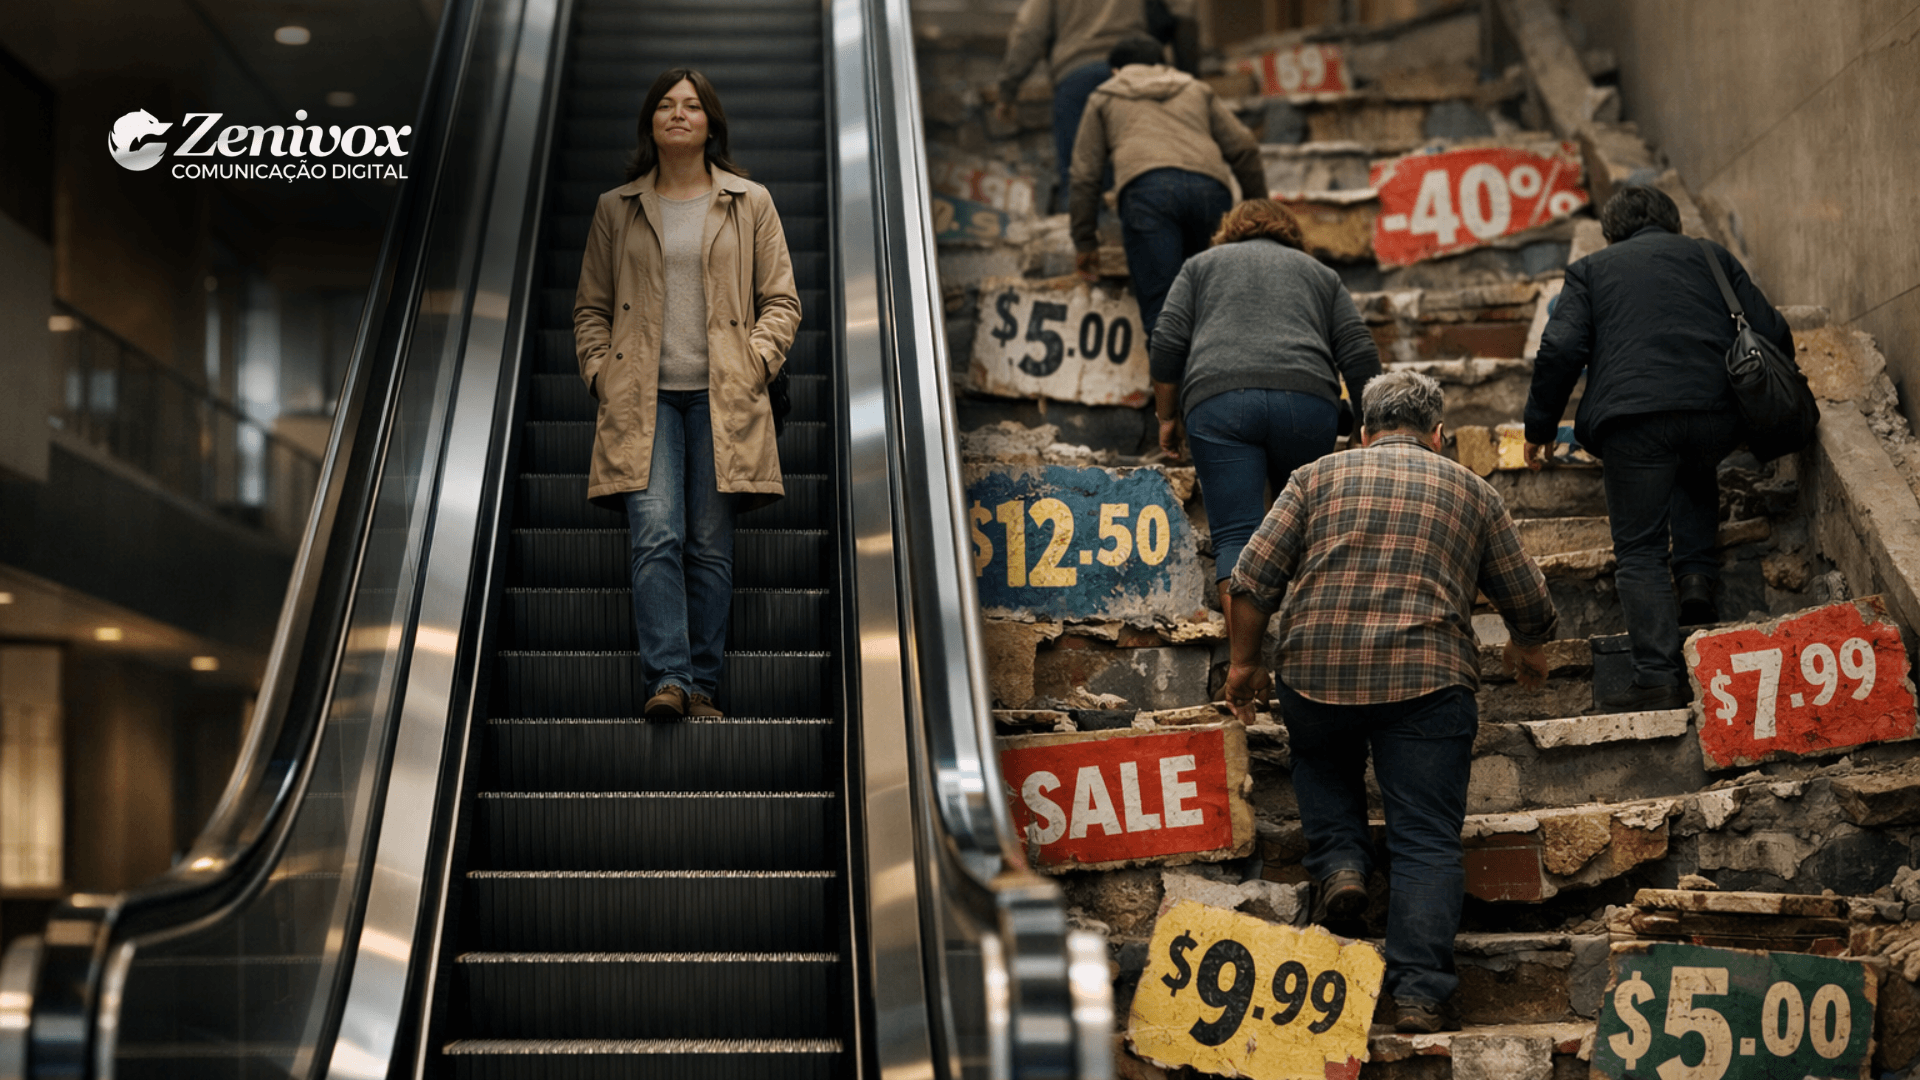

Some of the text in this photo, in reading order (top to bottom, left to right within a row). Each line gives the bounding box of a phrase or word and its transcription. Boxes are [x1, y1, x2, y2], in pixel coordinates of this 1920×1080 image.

[1383, 160, 1582, 246] -40%
[990, 285, 1133, 378] $5.00
[968, 497, 1170, 588] $12.50
[1709, 636, 1877, 741] $7.99
[1020, 753, 1205, 845] SALE
[1160, 929, 1348, 1047] $9.99
[1607, 965, 1852, 1080] $5.00
